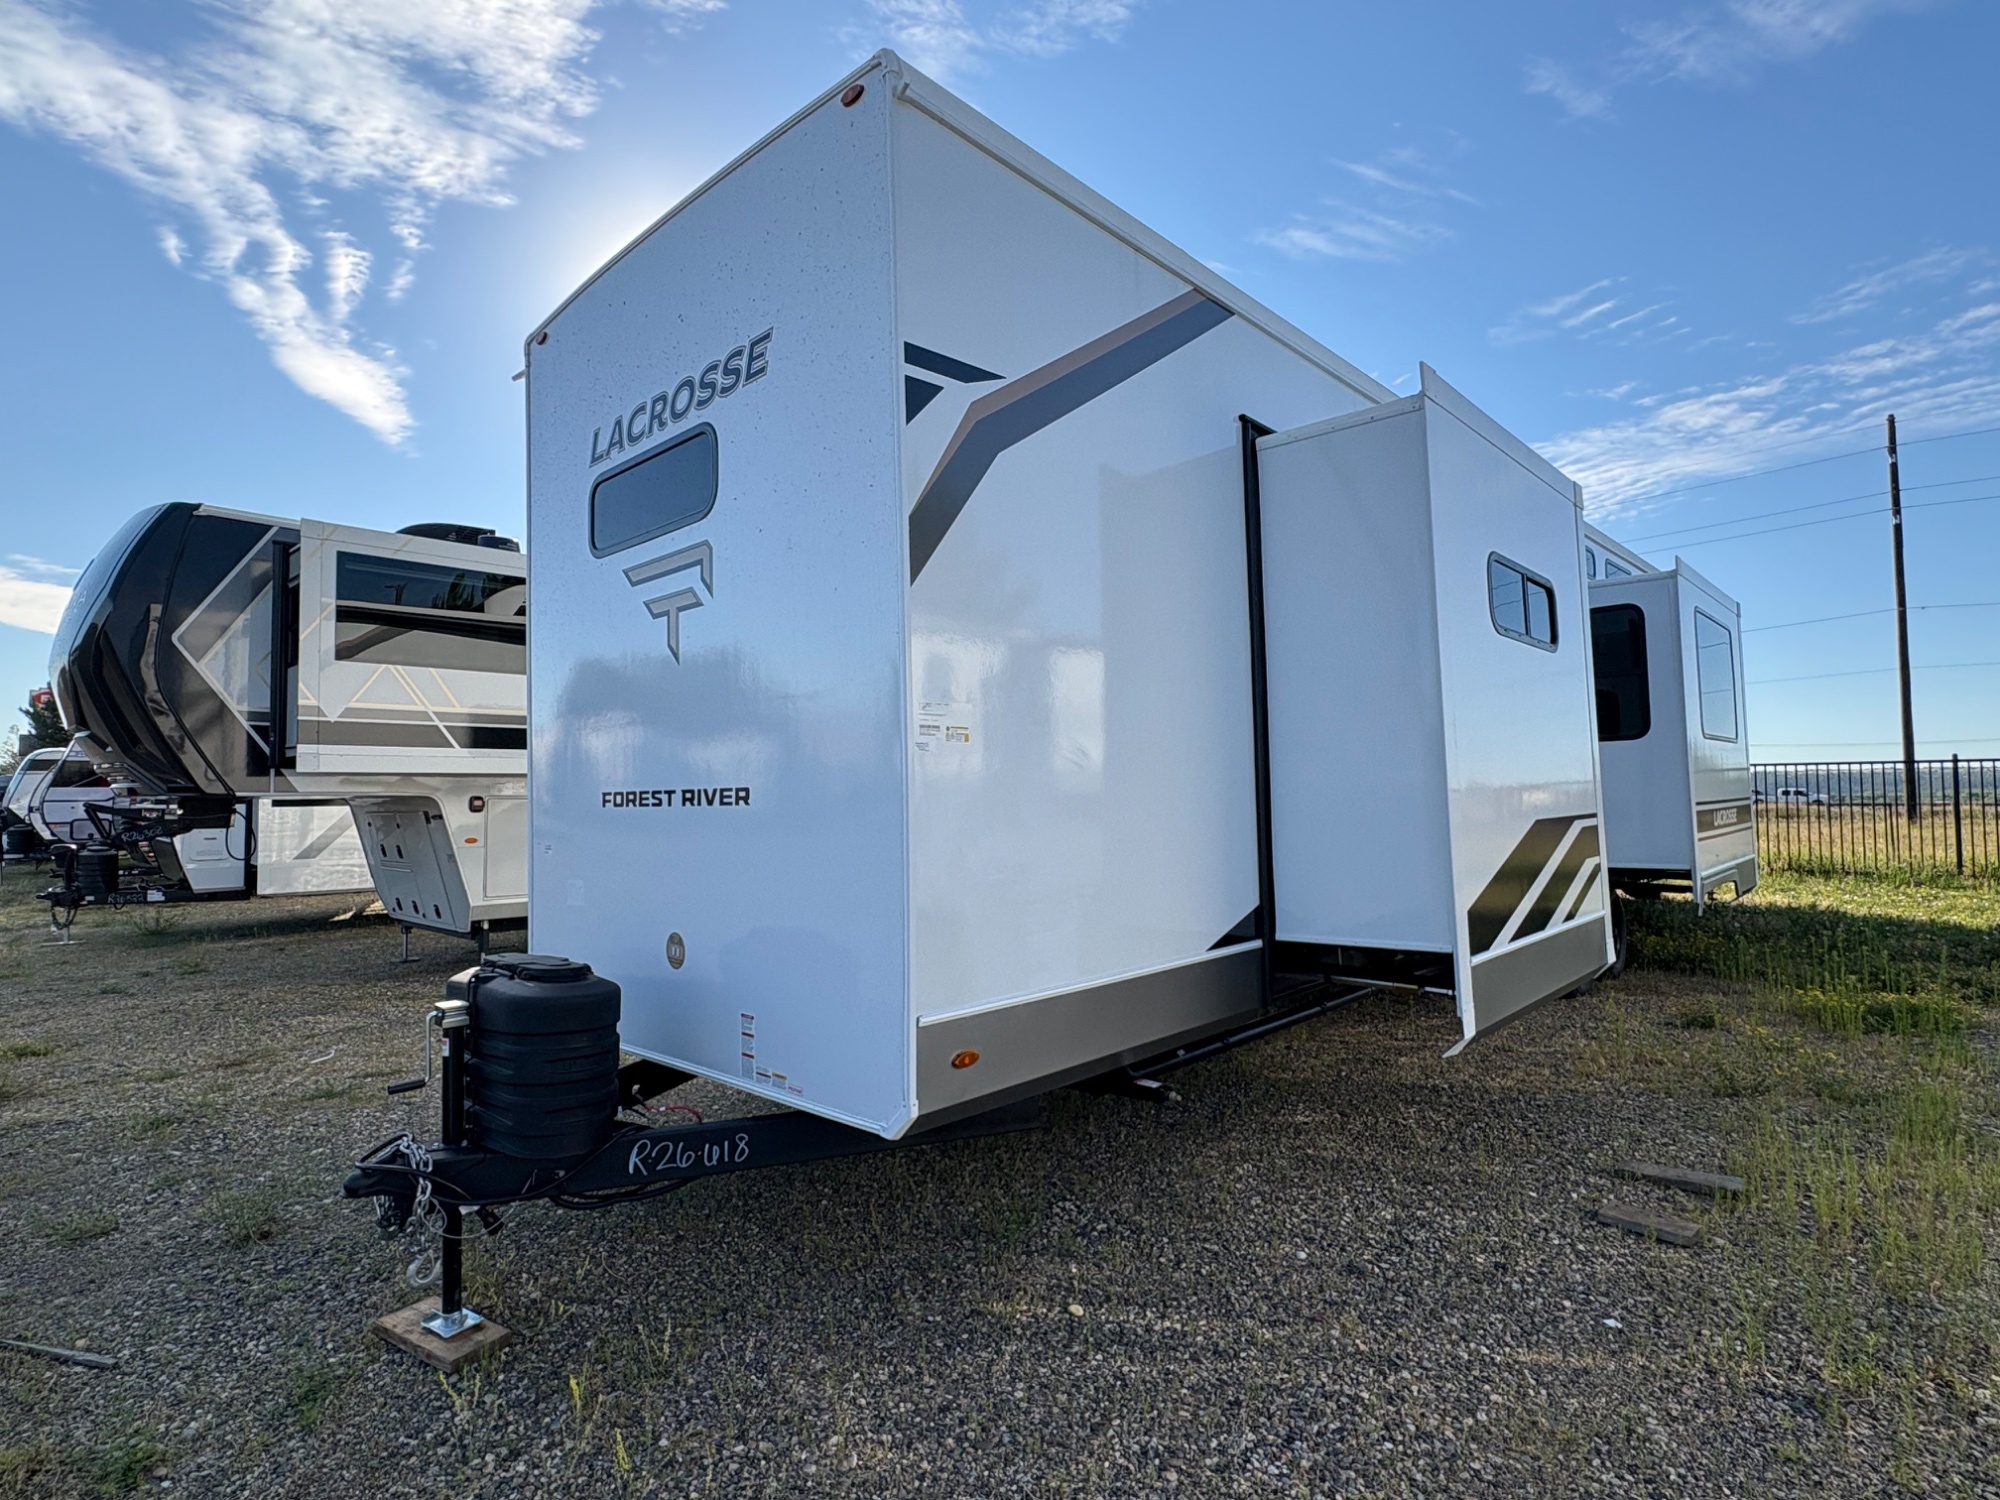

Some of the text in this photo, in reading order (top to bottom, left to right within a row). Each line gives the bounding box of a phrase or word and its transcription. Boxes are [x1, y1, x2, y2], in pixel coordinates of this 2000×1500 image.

[589, 326, 774, 468] LACROSSE
[602, 787, 750, 808] FOREST RIVER
